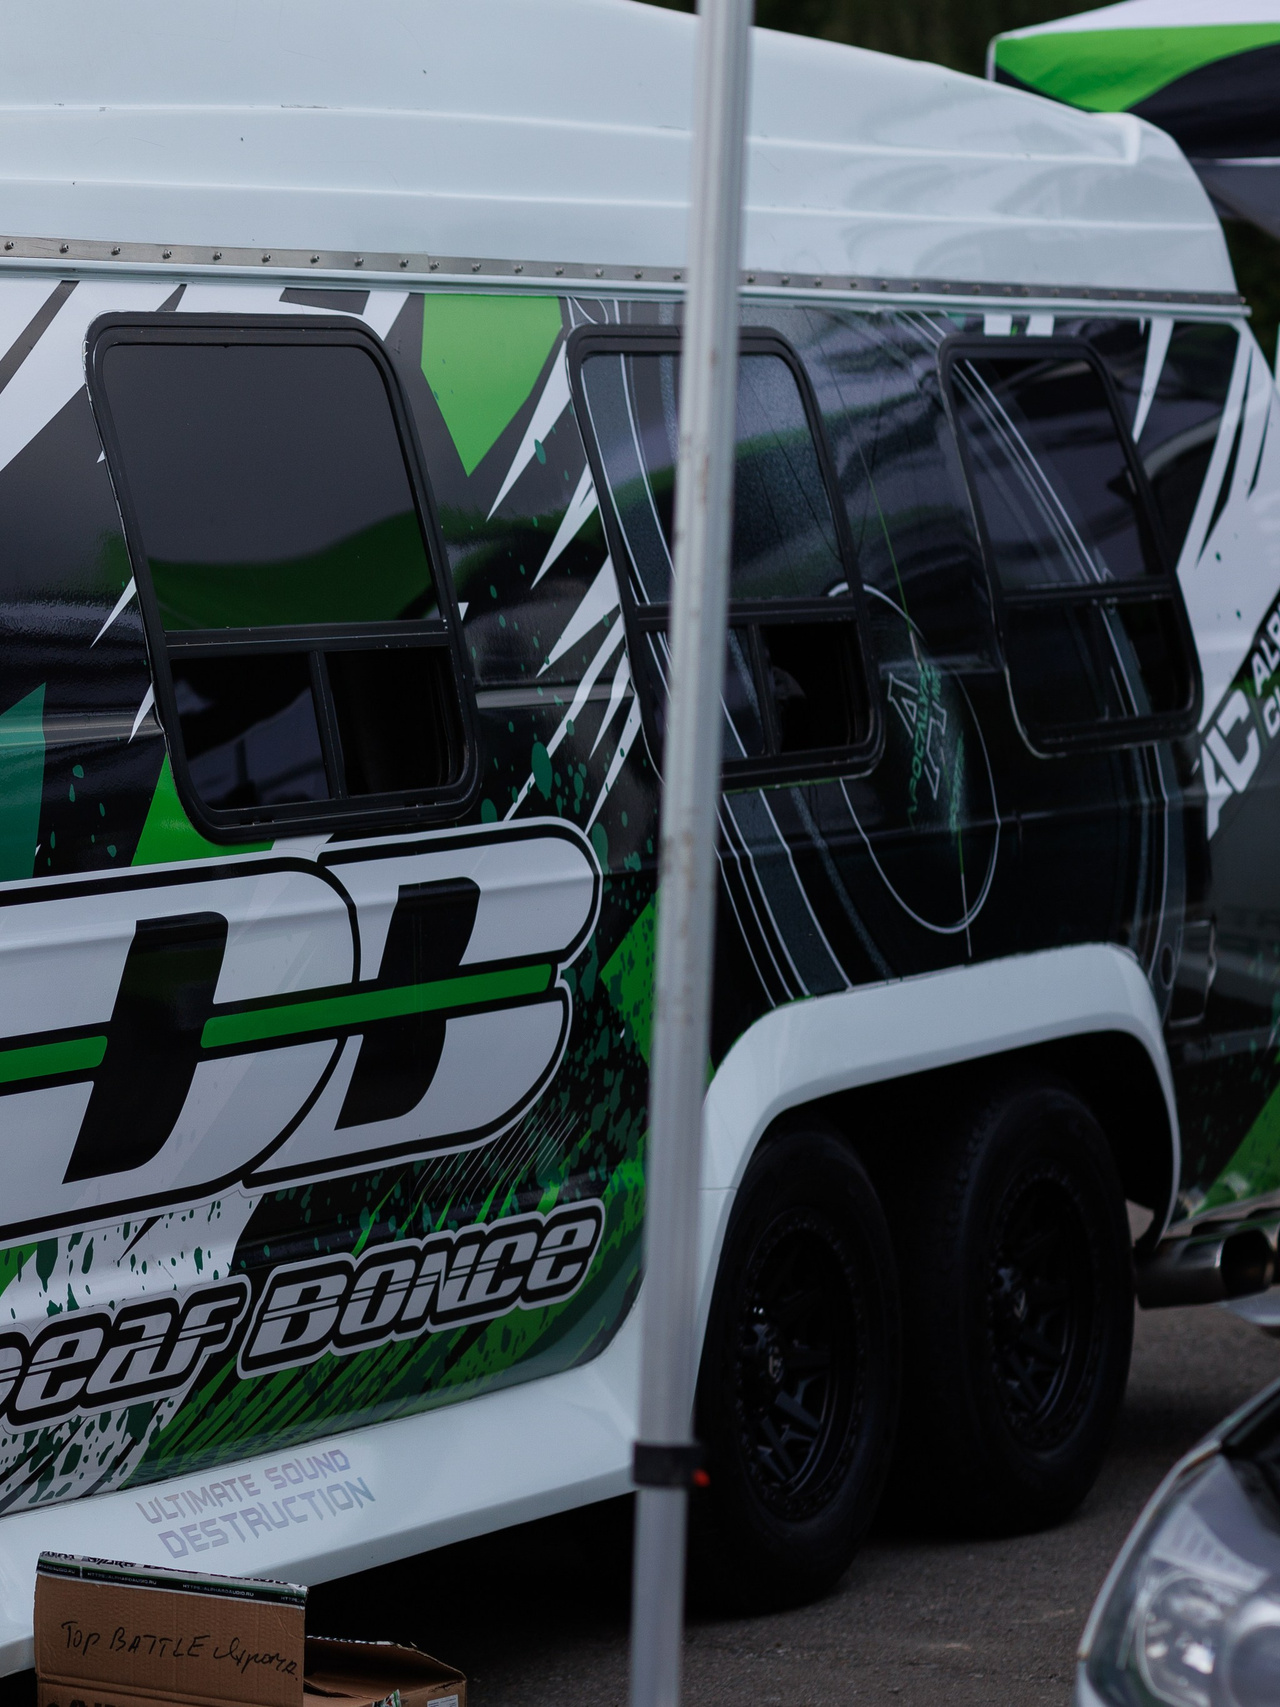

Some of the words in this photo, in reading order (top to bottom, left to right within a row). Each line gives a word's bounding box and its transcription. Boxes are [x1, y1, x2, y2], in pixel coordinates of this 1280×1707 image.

[135, 1473, 261, 1524] ULTIMATE
[264, 1449, 351, 1490] SOUND
[157, 1476, 376, 1559] DESTRUCTION
[110, 1626, 211, 1658] BATTLE
